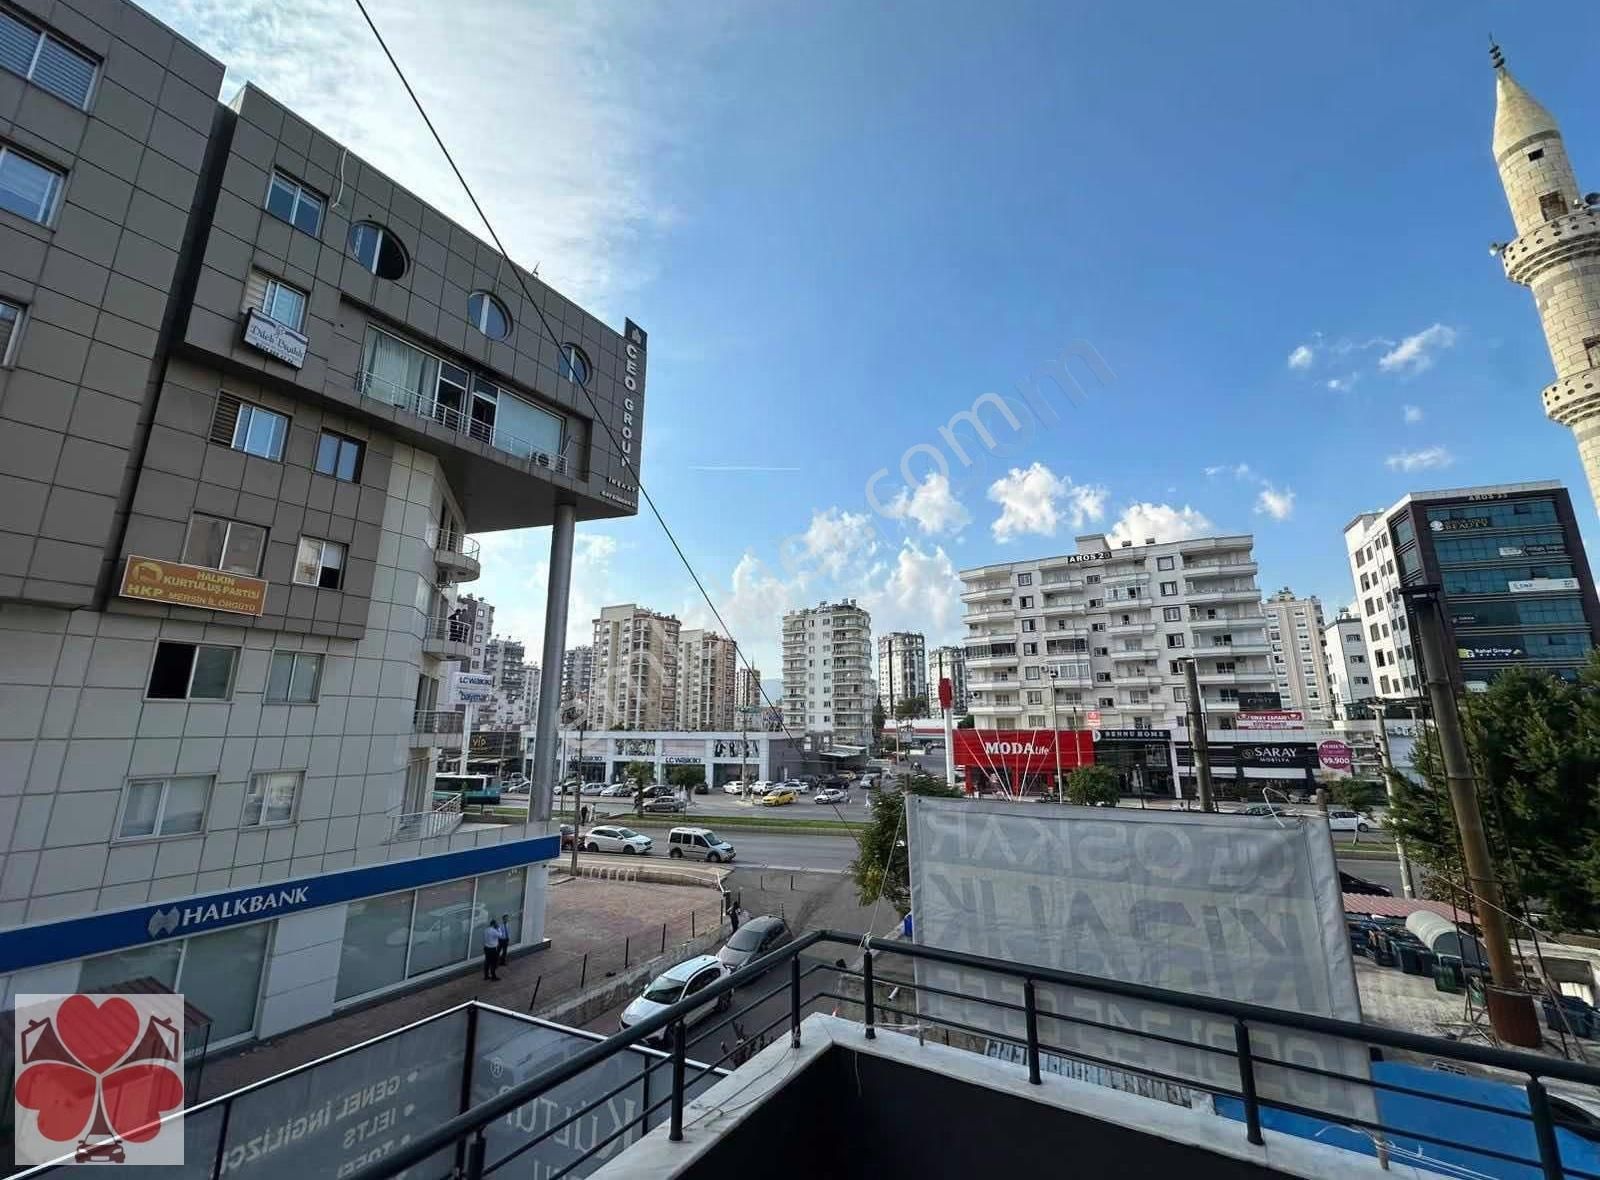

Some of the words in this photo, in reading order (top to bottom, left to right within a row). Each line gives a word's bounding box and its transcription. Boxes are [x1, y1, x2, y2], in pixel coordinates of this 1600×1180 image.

[624, 344, 640, 392] CEO
[1069, 554, 1096, 563] AROS
[127, 583, 164, 598] HKP
[984, 741, 1036, 756] MODA
[1254, 747, 1297, 758] SARAY
[181, 886, 309, 926] HALKBANK
